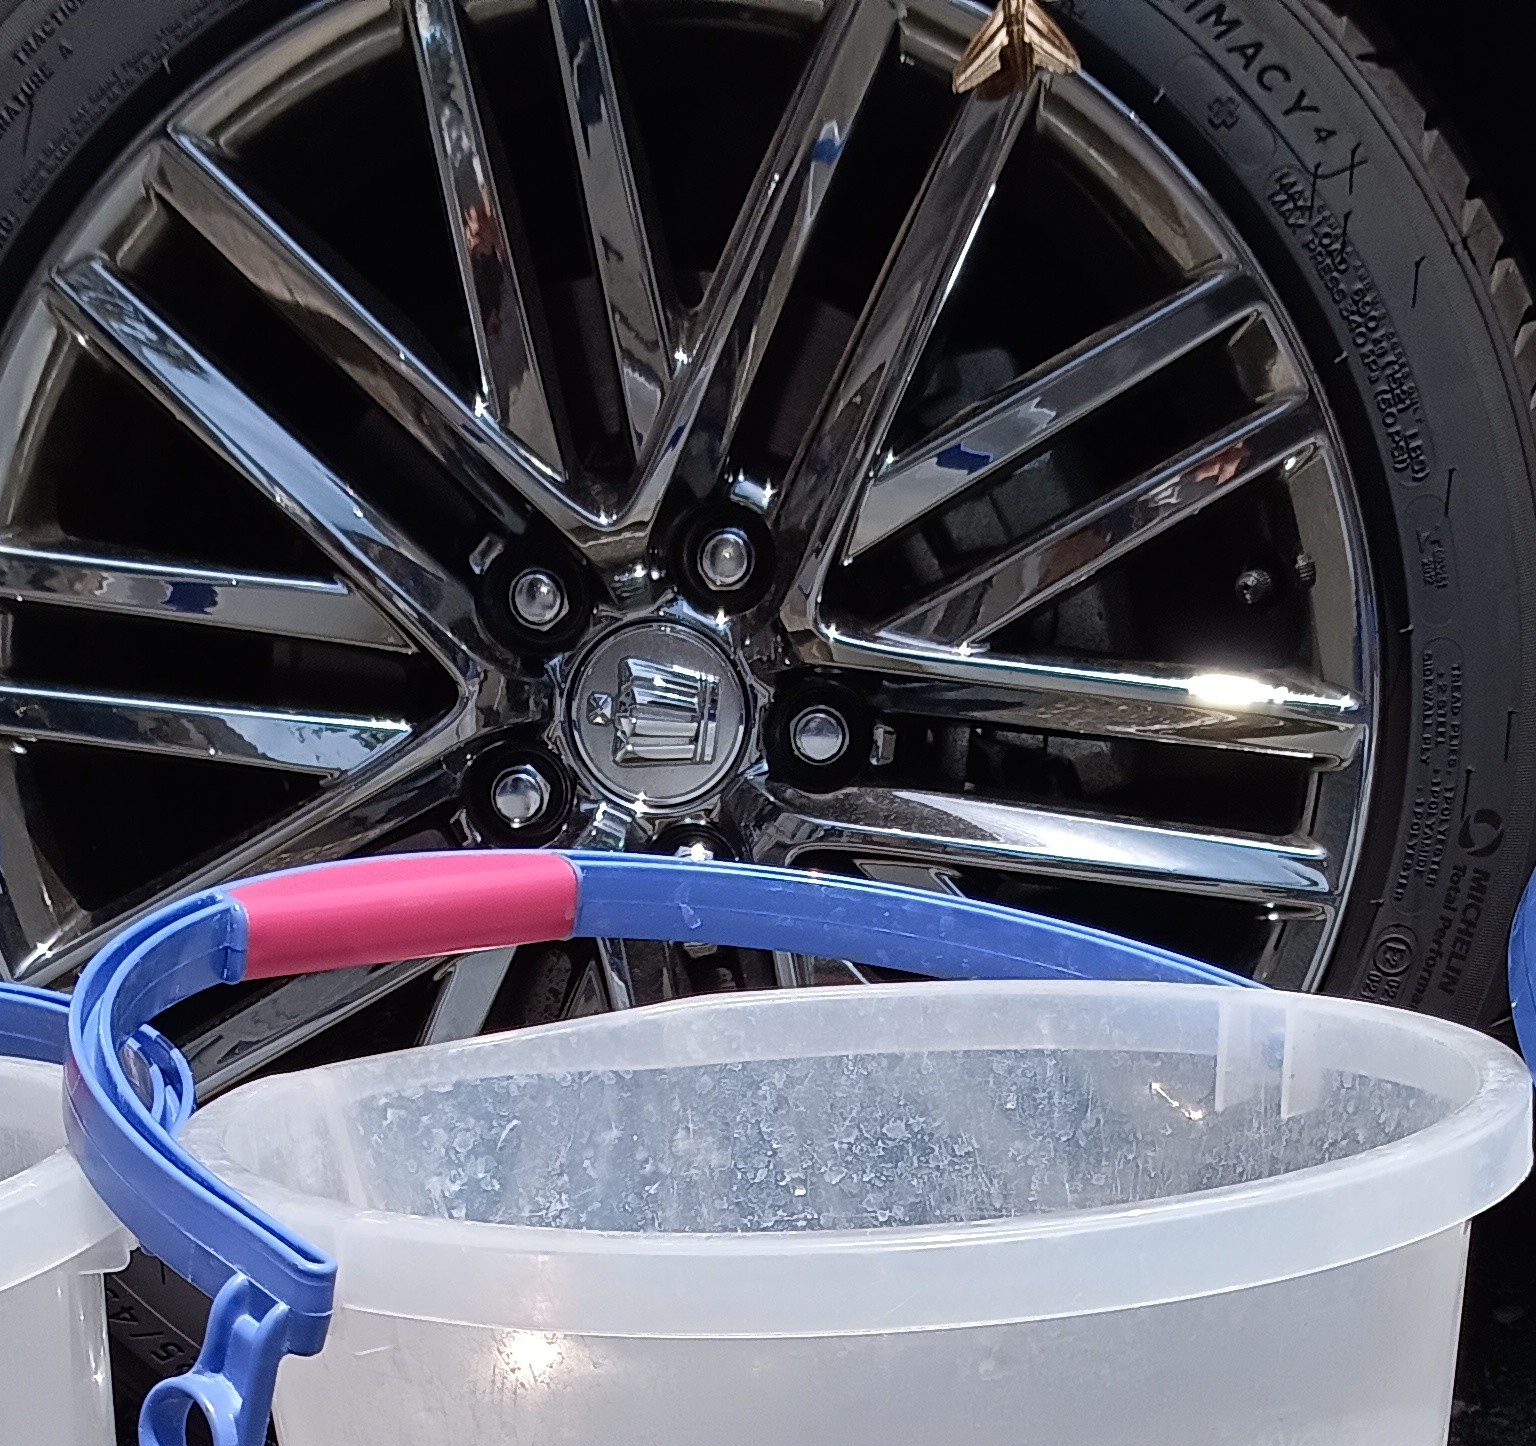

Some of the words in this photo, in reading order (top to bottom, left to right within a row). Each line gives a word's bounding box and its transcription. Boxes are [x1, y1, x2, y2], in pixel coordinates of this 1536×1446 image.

[13, 0, 83, 66] TRACTIO
[1442, 864, 1467, 912] Total
[1410, 915, 1454, 1005] Performa
[1438, 867, 1491, 996] MICHELIN
